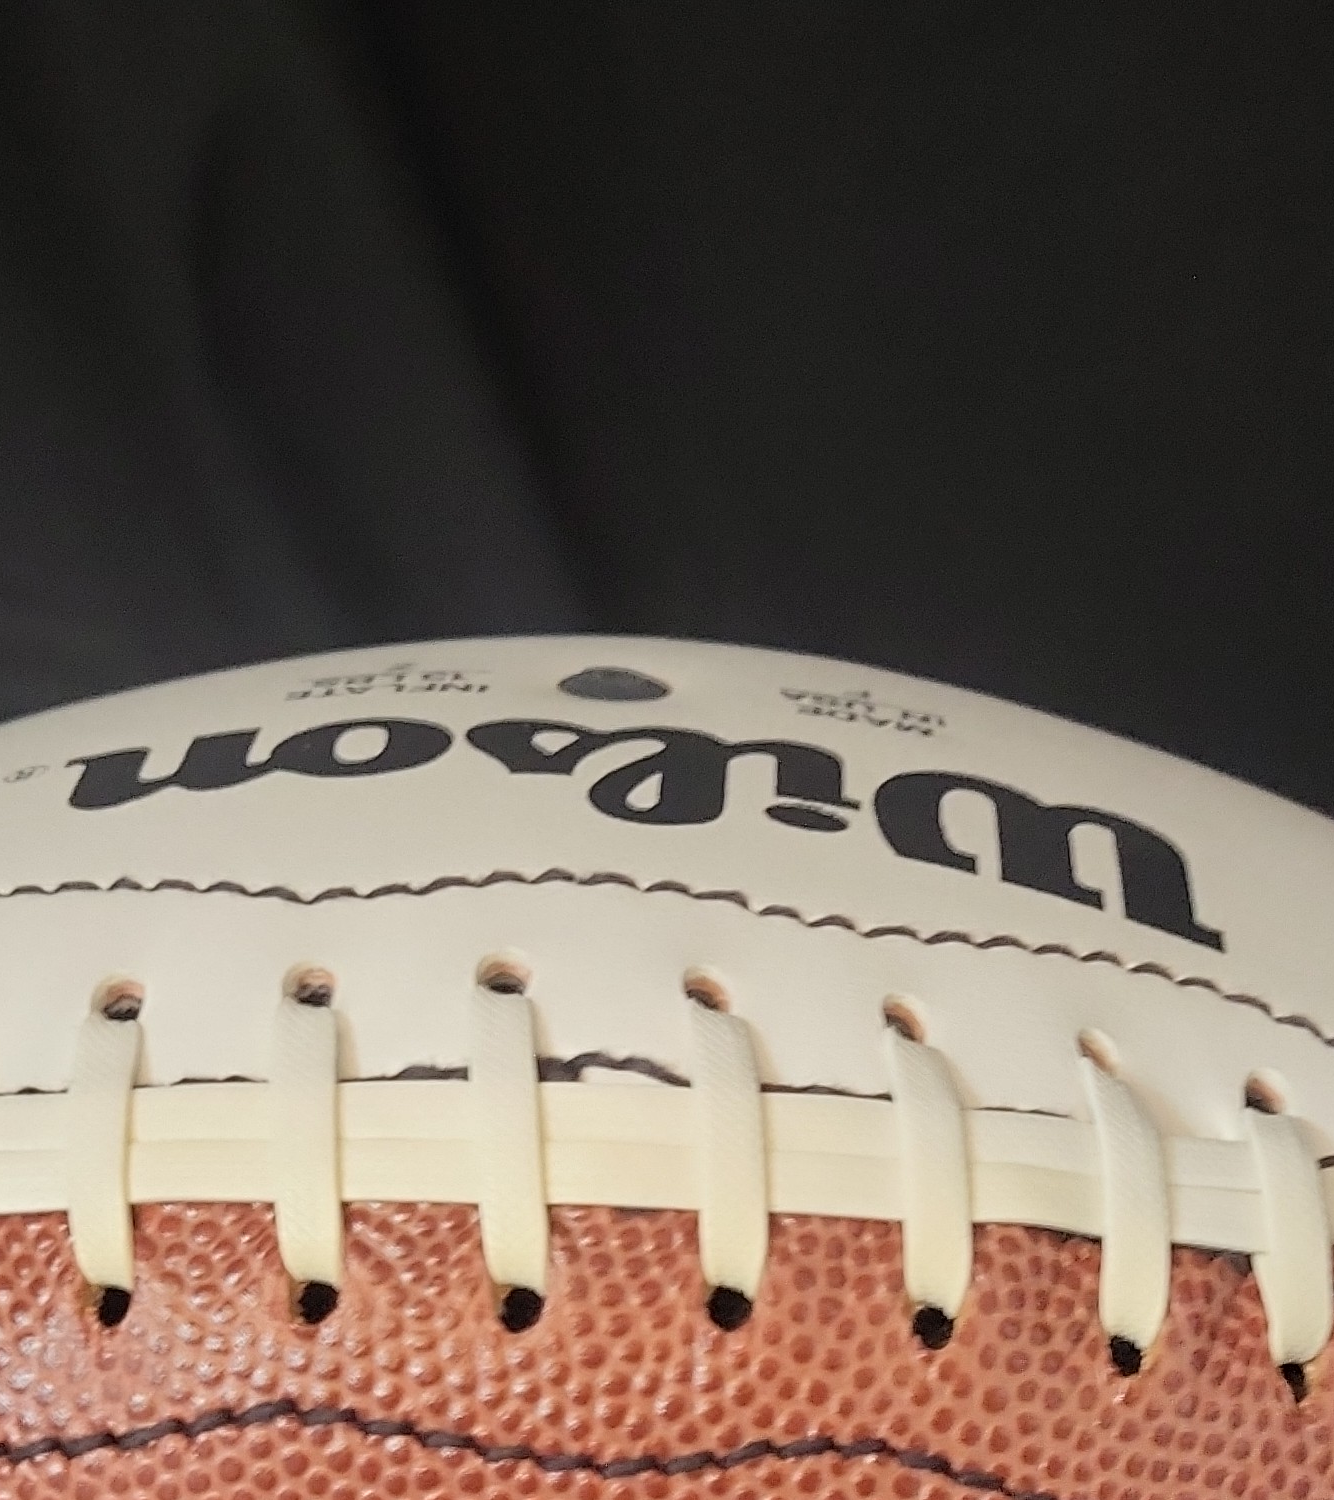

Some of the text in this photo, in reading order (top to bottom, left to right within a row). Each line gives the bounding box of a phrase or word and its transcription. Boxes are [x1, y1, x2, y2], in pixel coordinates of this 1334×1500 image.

[285, 683, 490, 702] INFLATE
[779, 688, 876, 714] USA
[797, 707, 934, 738] MADE
[65, 718, 1226, 955] Wilson
